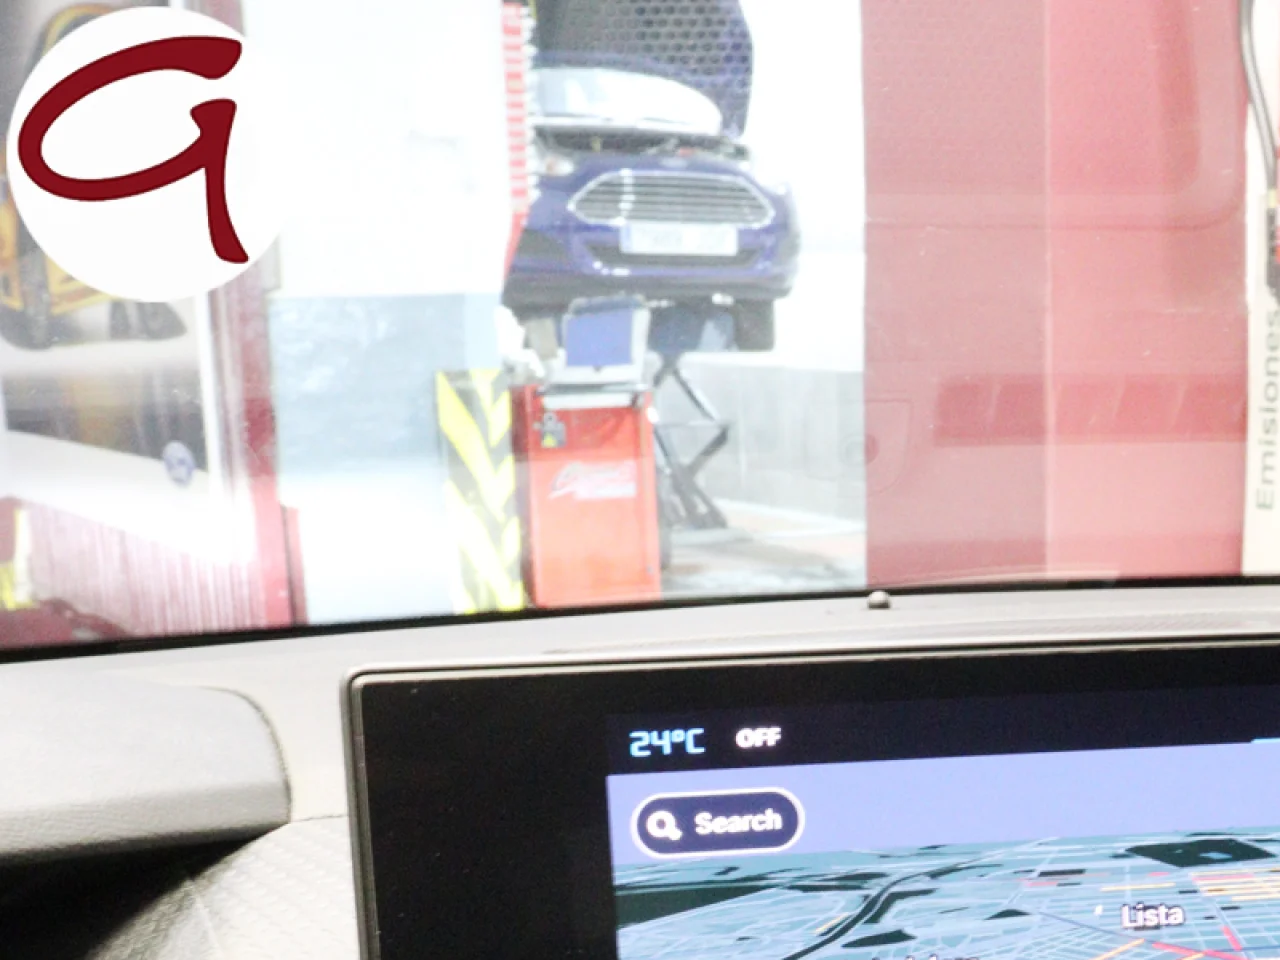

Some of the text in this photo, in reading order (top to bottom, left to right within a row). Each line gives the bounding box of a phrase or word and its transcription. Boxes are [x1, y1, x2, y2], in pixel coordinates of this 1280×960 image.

[1256, 308, 1280, 510] Emisiones
[735, 726, 783, 748] OFF
[694, 808, 783, 835] Search
[1121, 902, 1185, 928] Lista
